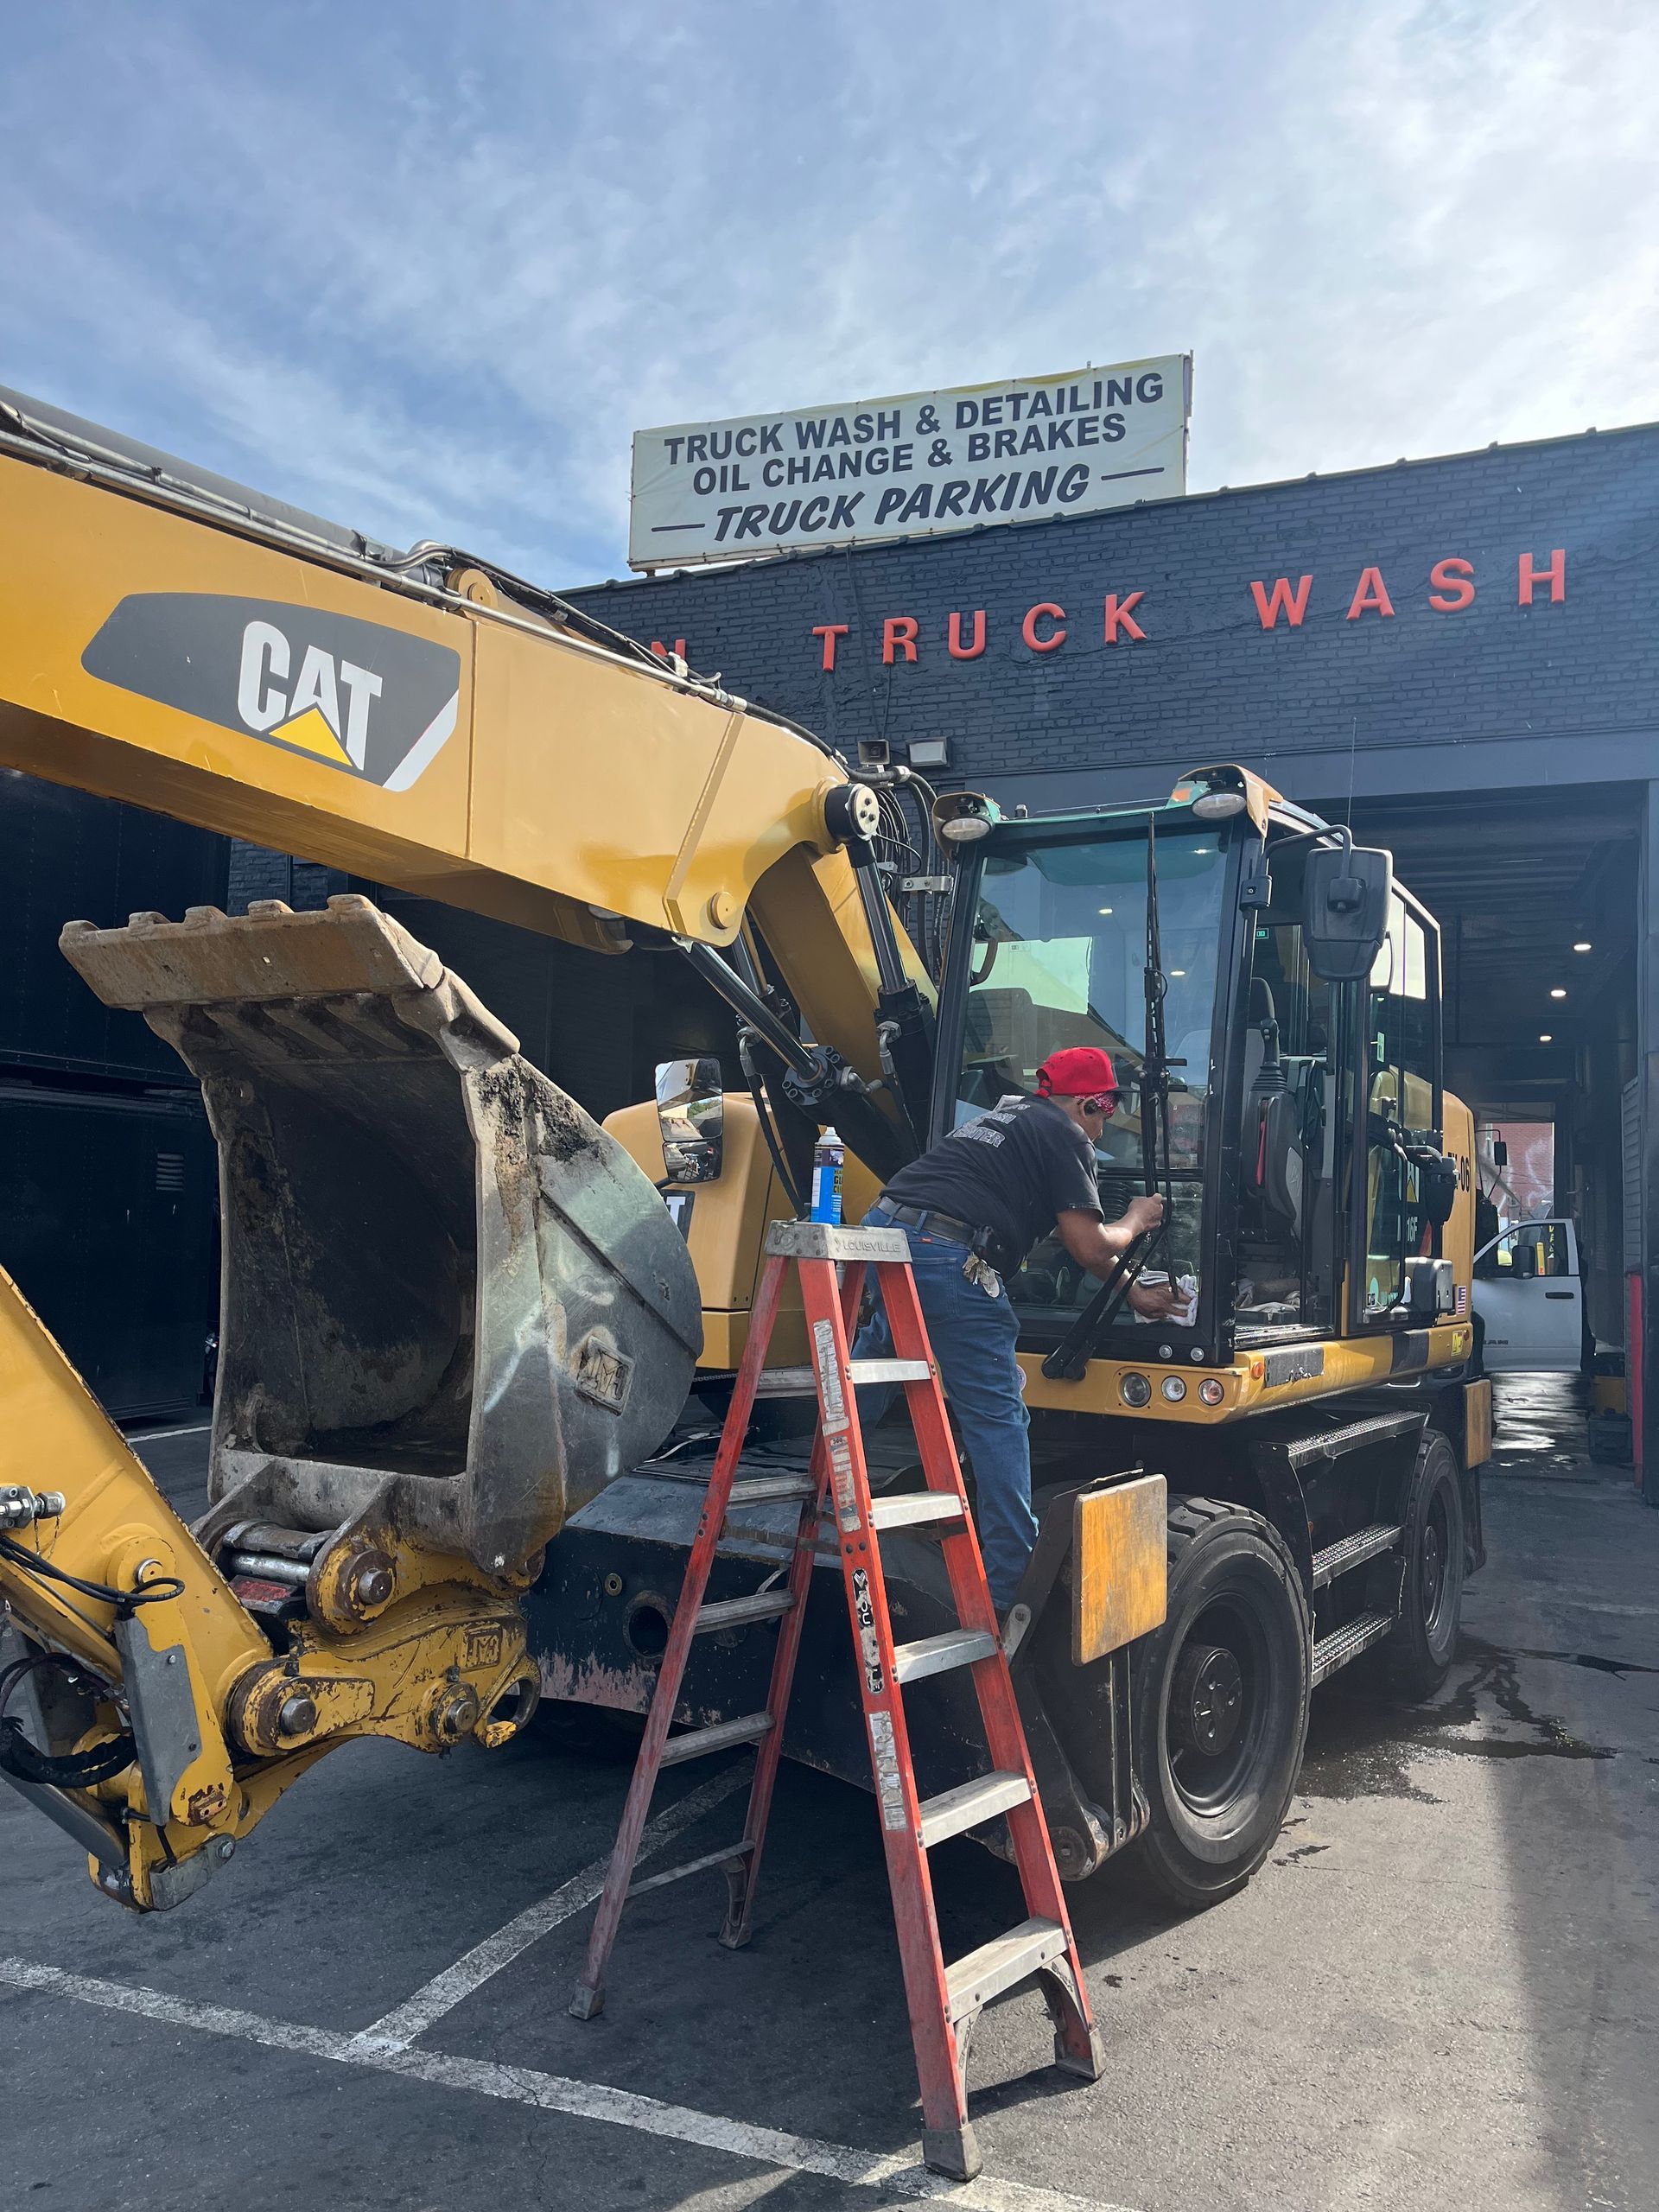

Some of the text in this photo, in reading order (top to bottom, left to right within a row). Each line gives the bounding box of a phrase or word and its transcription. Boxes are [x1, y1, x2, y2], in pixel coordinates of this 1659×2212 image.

[664, 372, 1164, 465] TRUCK WASH & DETAILING
[693, 413, 1126, 495] OIL CHANGE & BRAKES
[714, 463, 1090, 542] TRUCK PARKING
[812, 591, 1147, 671] TRUCK
[1250, 549, 1566, 631] WASH
[238, 620, 383, 771] CAT
[843, 1240, 902, 1253] LOUISVILLE
